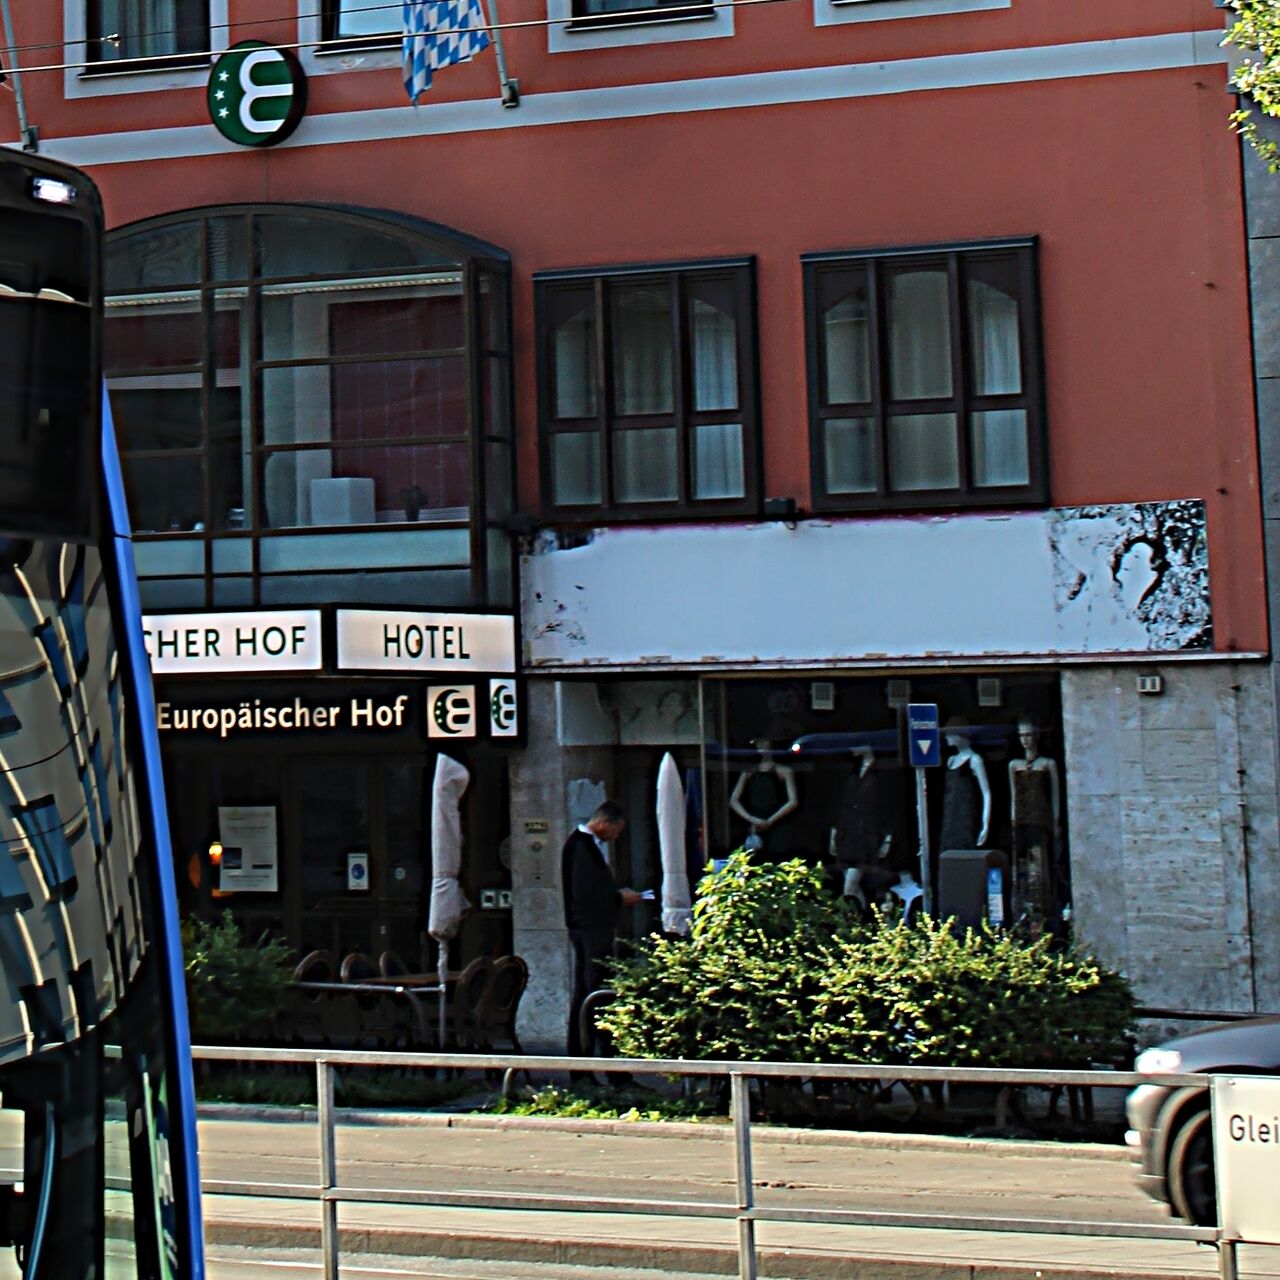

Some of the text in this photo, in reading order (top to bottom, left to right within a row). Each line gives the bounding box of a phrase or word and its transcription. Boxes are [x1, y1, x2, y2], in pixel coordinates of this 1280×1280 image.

[236, 626, 306, 656] HOF
[383, 624, 470, 659] HOTEL
[157, 695, 408, 737] Europäischer Hof
[1230, 1114, 1280, 1143] Glei
